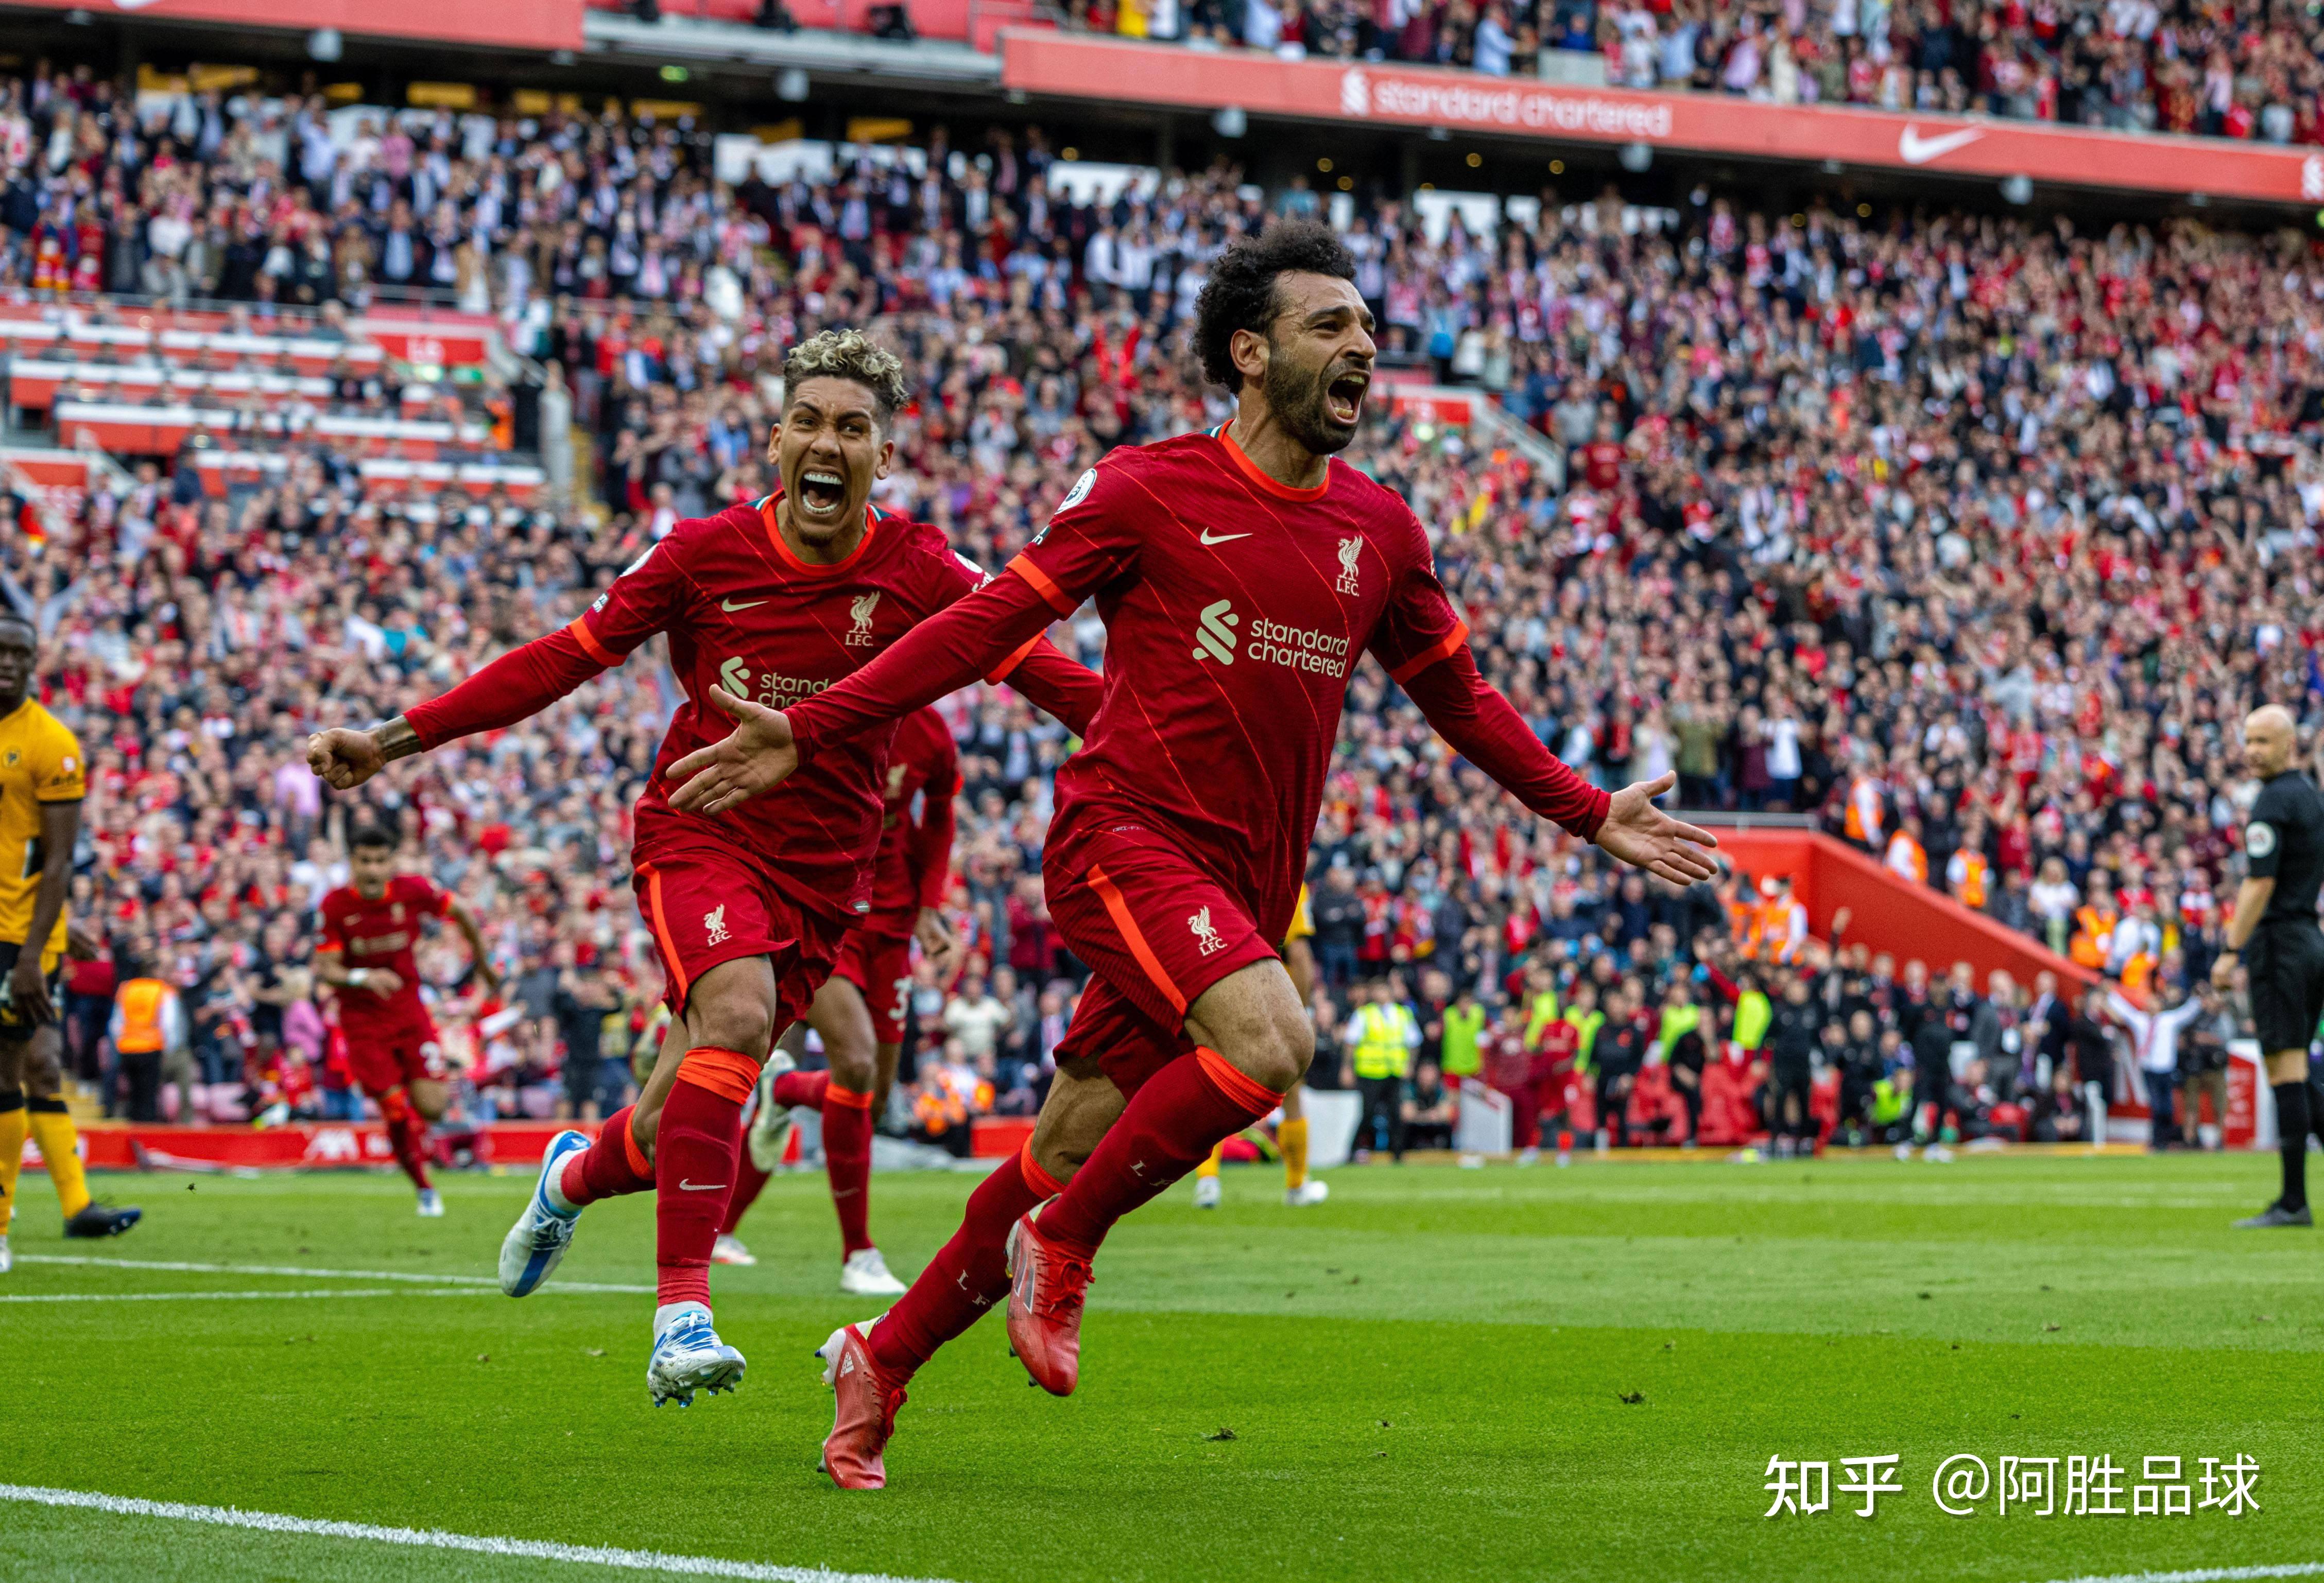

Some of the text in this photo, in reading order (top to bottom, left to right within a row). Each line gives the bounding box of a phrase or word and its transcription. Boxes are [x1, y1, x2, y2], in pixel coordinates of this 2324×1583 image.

[1373, 80, 1672, 138] standard chartered
[1250, 618, 1350, 656] standard
[1248, 640, 1347, 679] chartered
[758, 691, 807, 708] cha
[760, 672, 836, 694] stand
